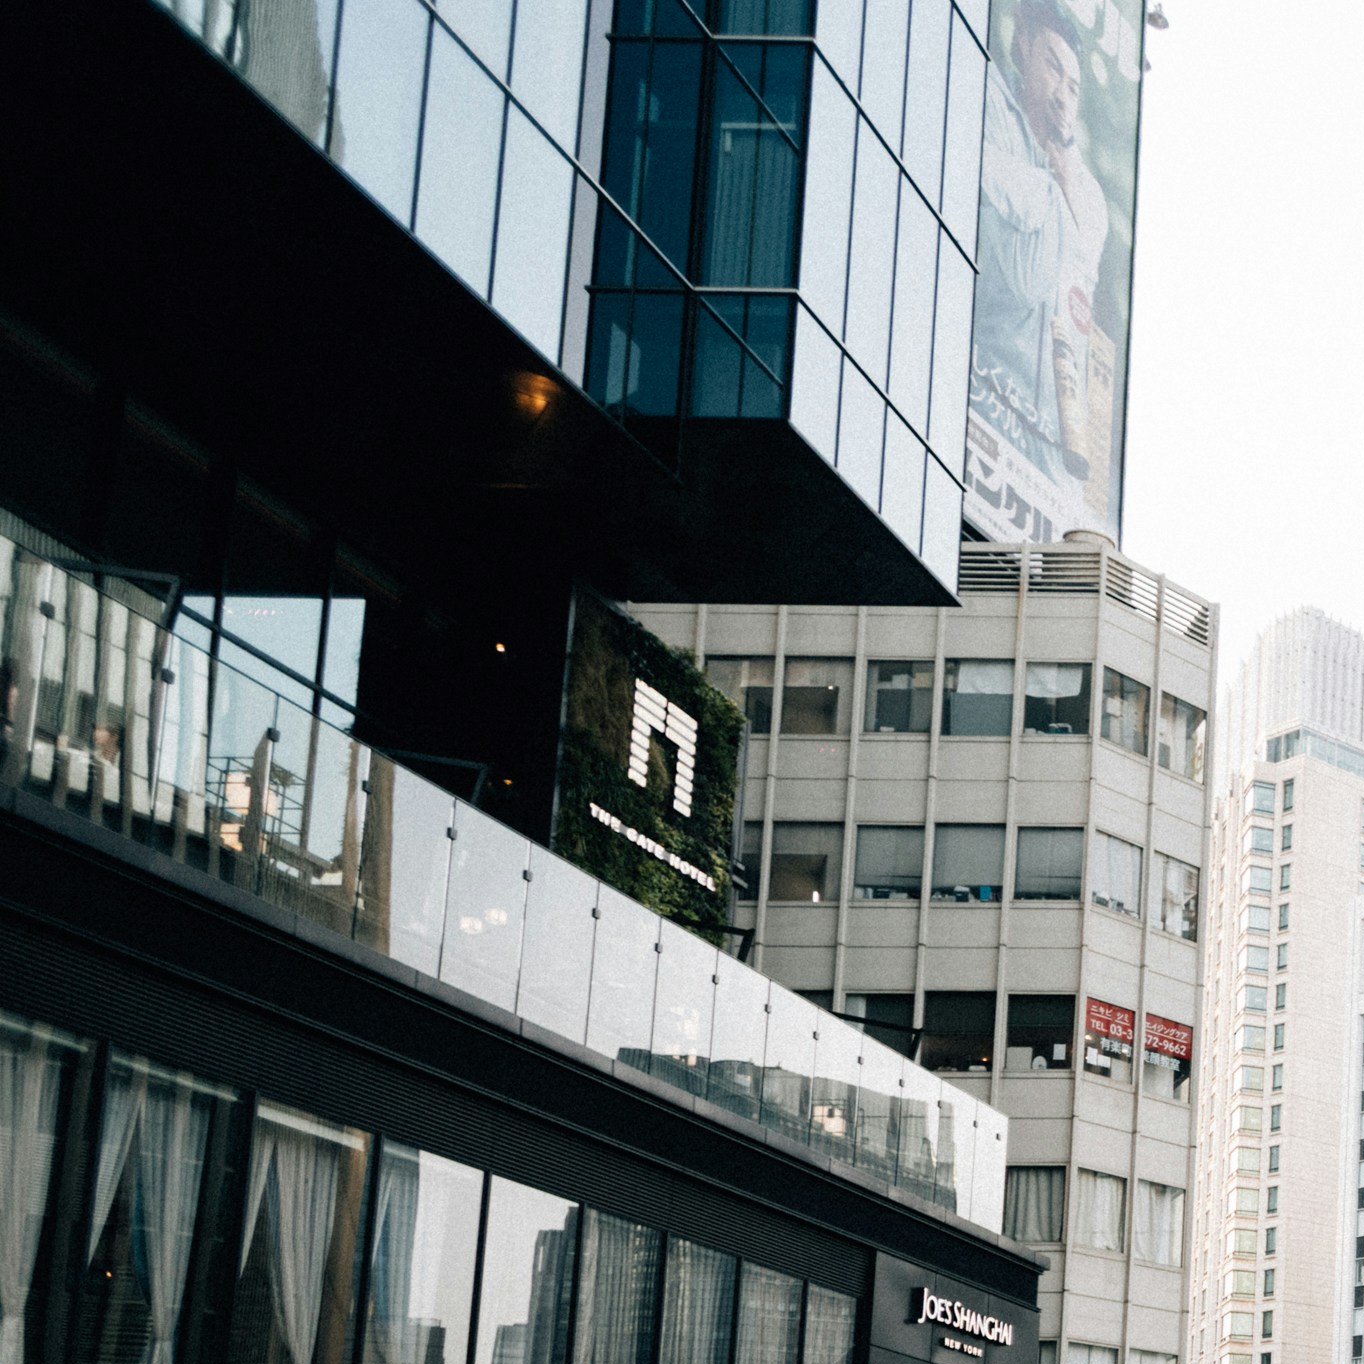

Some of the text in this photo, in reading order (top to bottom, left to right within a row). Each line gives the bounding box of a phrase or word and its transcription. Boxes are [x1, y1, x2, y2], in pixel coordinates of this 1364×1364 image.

[589, 802, 717, 892] THE GATE HOTEL
[952, 1301, 1013, 1346] SHANGHAI
[944, 1337, 984, 1358] NEW YORK
